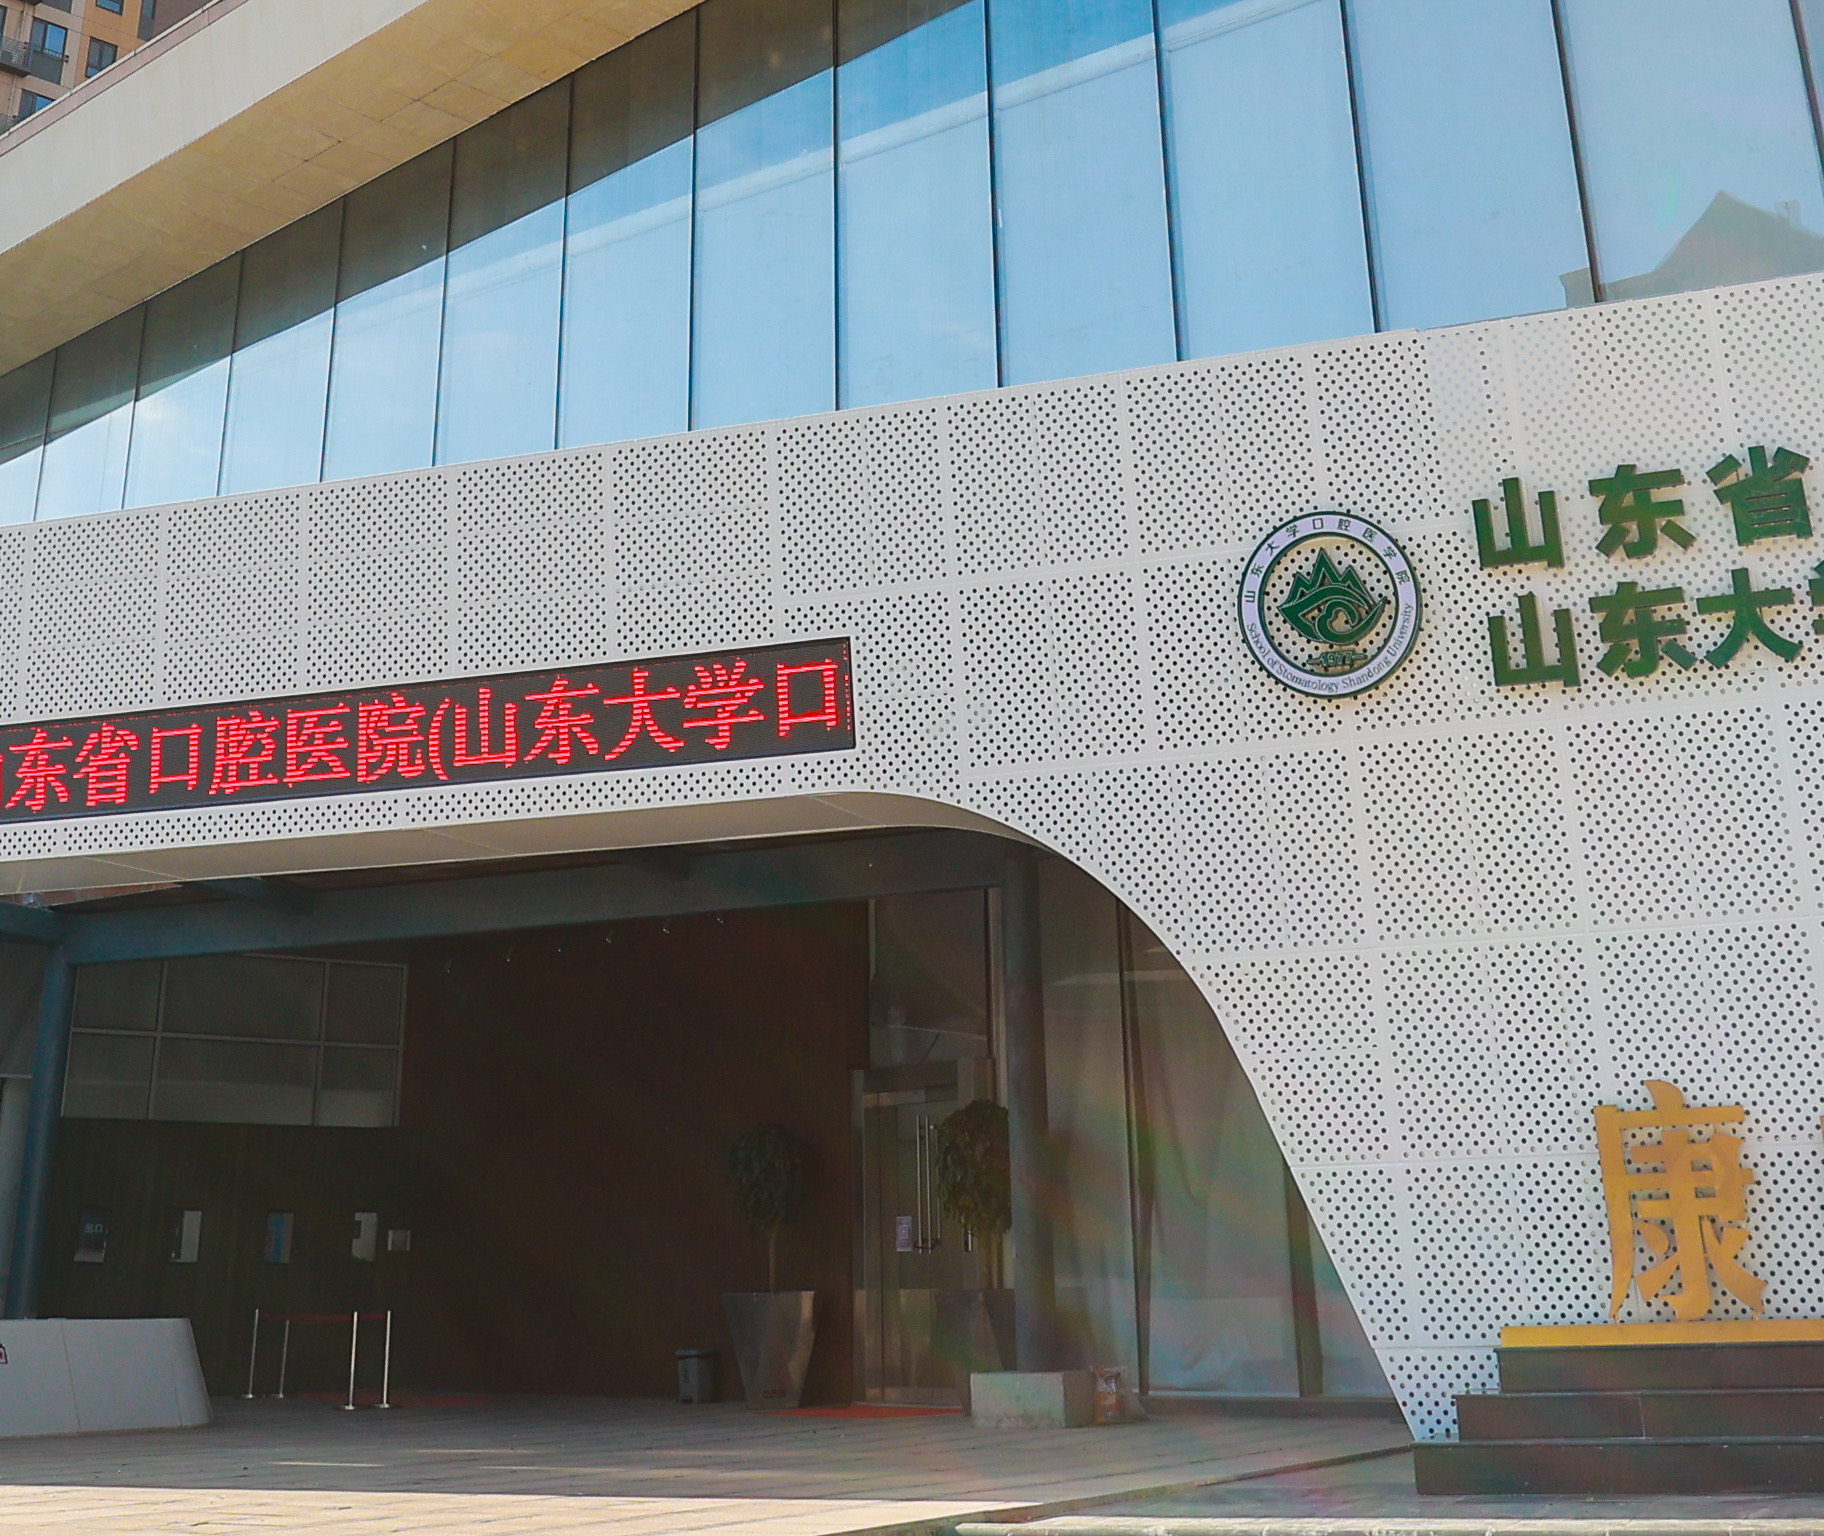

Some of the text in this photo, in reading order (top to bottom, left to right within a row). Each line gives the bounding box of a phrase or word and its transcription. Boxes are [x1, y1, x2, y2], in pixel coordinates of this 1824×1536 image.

[1244, 517, 1412, 603] 山东大学口腔医学院
[1247, 622, 1272, 660] School
[1276, 663, 1341, 693] Stomatology
[1341, 656, 1392, 689] Shandong
[1387, 602, 1415, 657] University
